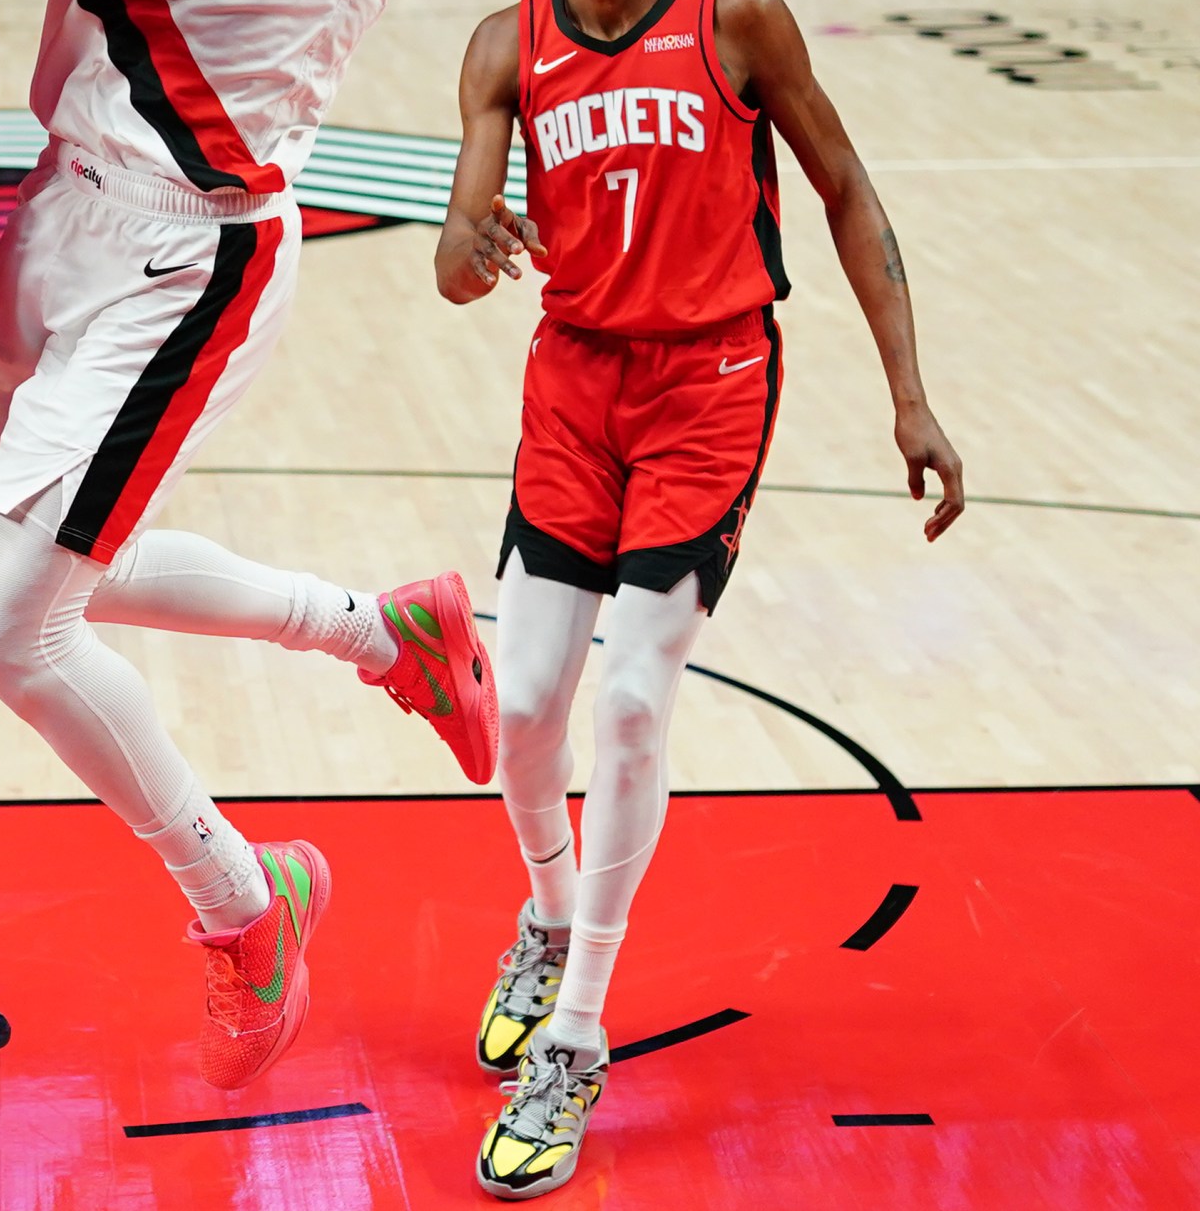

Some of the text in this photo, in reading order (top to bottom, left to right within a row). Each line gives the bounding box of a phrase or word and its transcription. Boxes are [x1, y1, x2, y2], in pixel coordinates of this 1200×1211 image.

[534, 87, 705, 173] ROCKETS
[71, 158, 103, 189] ripcity
[605, 168, 639, 253] 7
